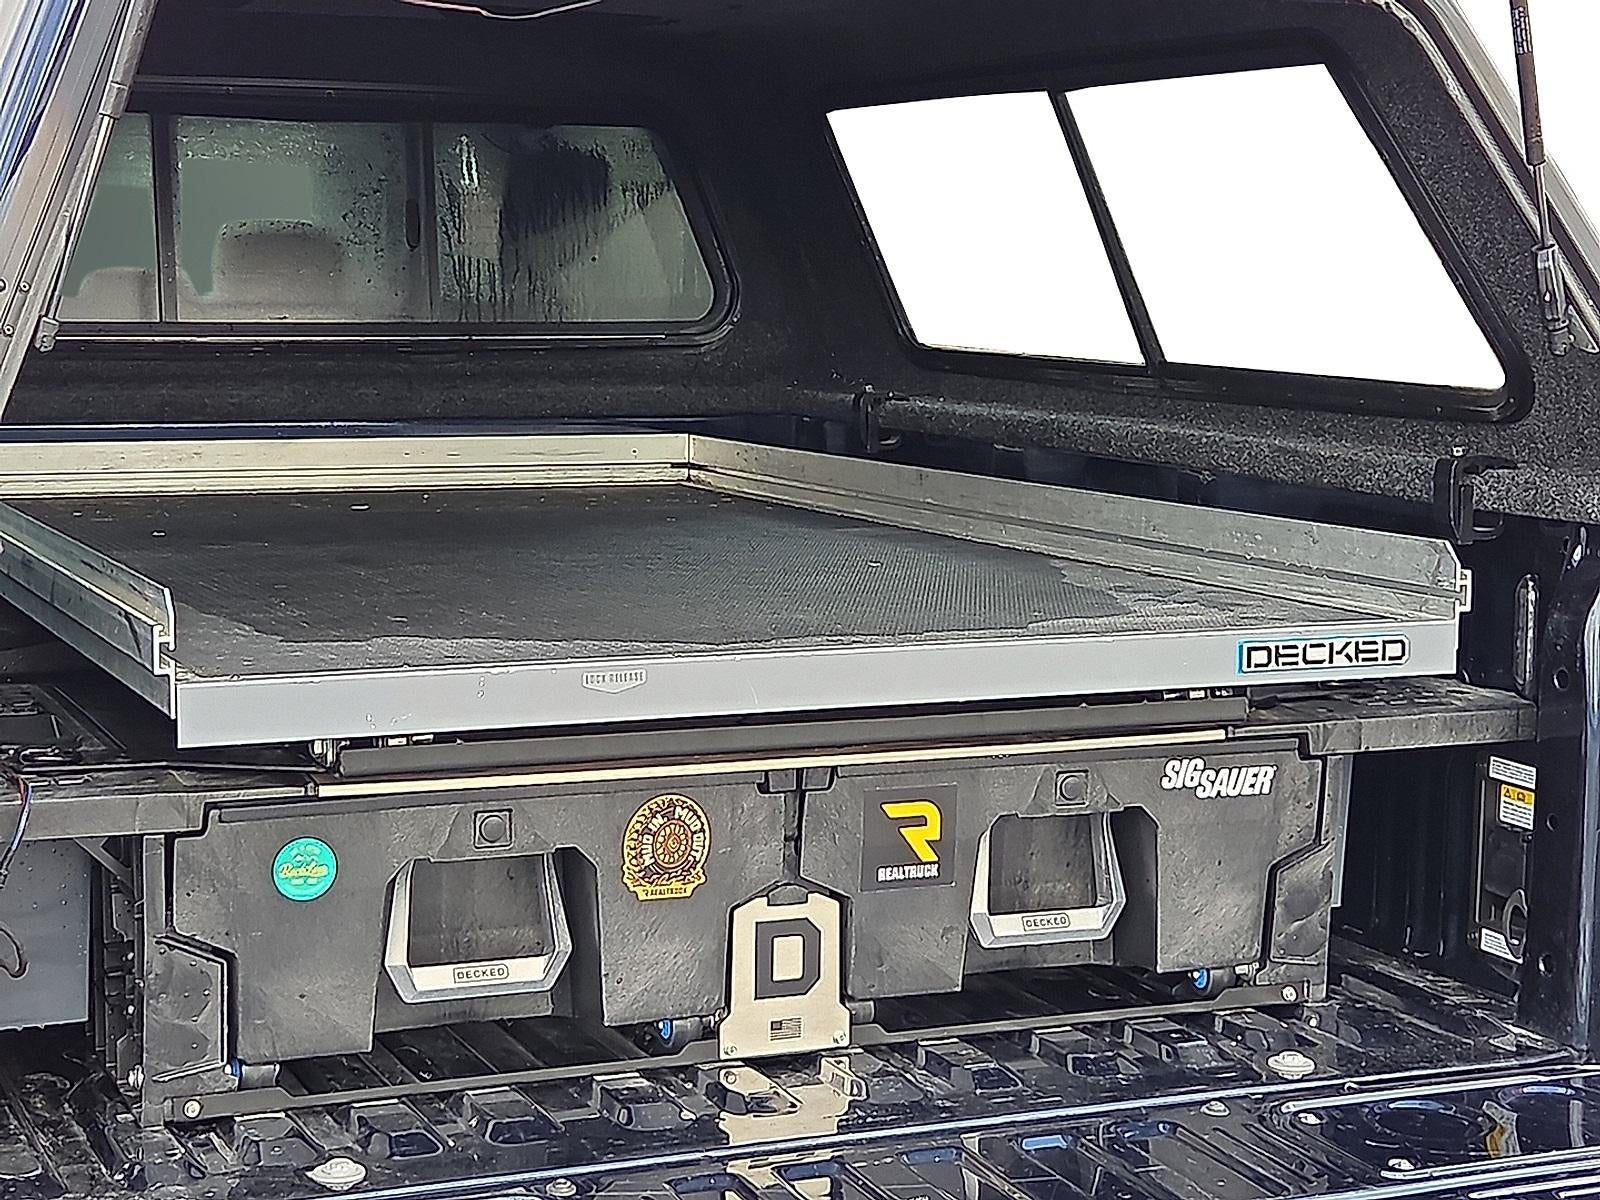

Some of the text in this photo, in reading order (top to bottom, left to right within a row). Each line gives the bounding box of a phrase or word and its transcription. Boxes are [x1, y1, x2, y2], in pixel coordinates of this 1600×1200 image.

[1246, 638, 1406, 669] DECKED
[1160, 757, 1275, 799] SIG SAUER
[641, 833, 656, 867] MUD
[674, 805, 702, 833] MUD
[877, 863, 940, 882] REALTRUCK
[1025, 916, 1067, 928] DECKED
[456, 967, 505, 980] DECKED
[754, 917, 821, 1000] D
